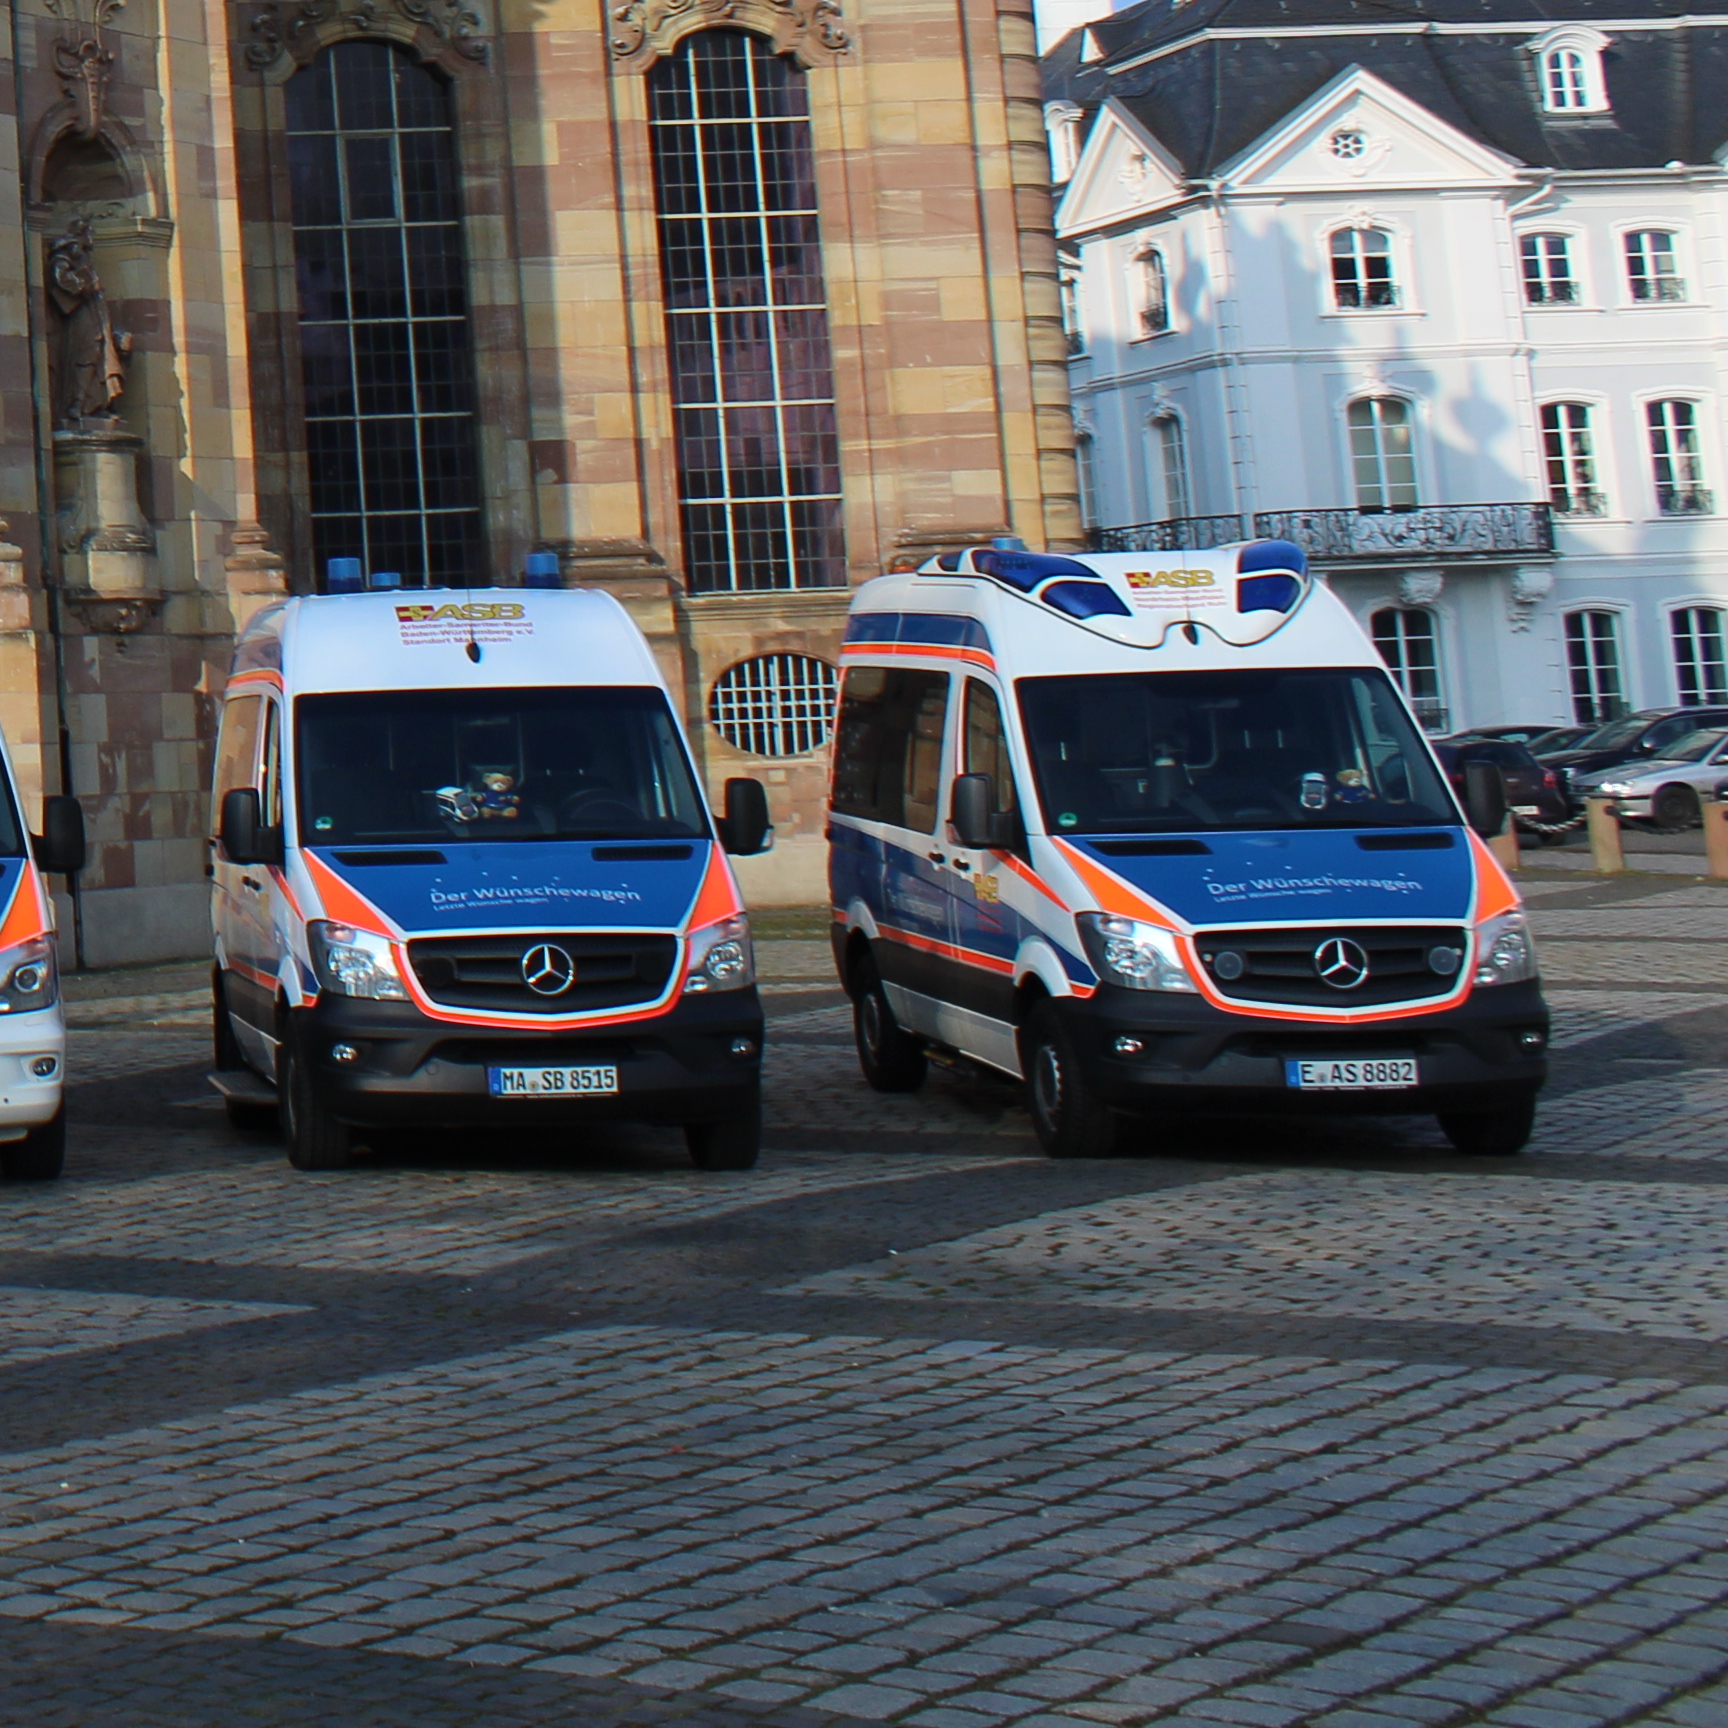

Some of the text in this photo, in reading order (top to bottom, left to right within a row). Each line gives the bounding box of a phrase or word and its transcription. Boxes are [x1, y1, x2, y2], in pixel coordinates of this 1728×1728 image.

[1150, 569, 1215, 588] ASB
[427, 602, 525, 621] ASB
[430, 885, 641, 904] Der Wünschewagen
[1207, 875, 1423, 895] Der Wünschewagen
[502, 1068, 615, 1091] MA SB 8515
[1301, 1061, 1414, 1084] E AS 8882
